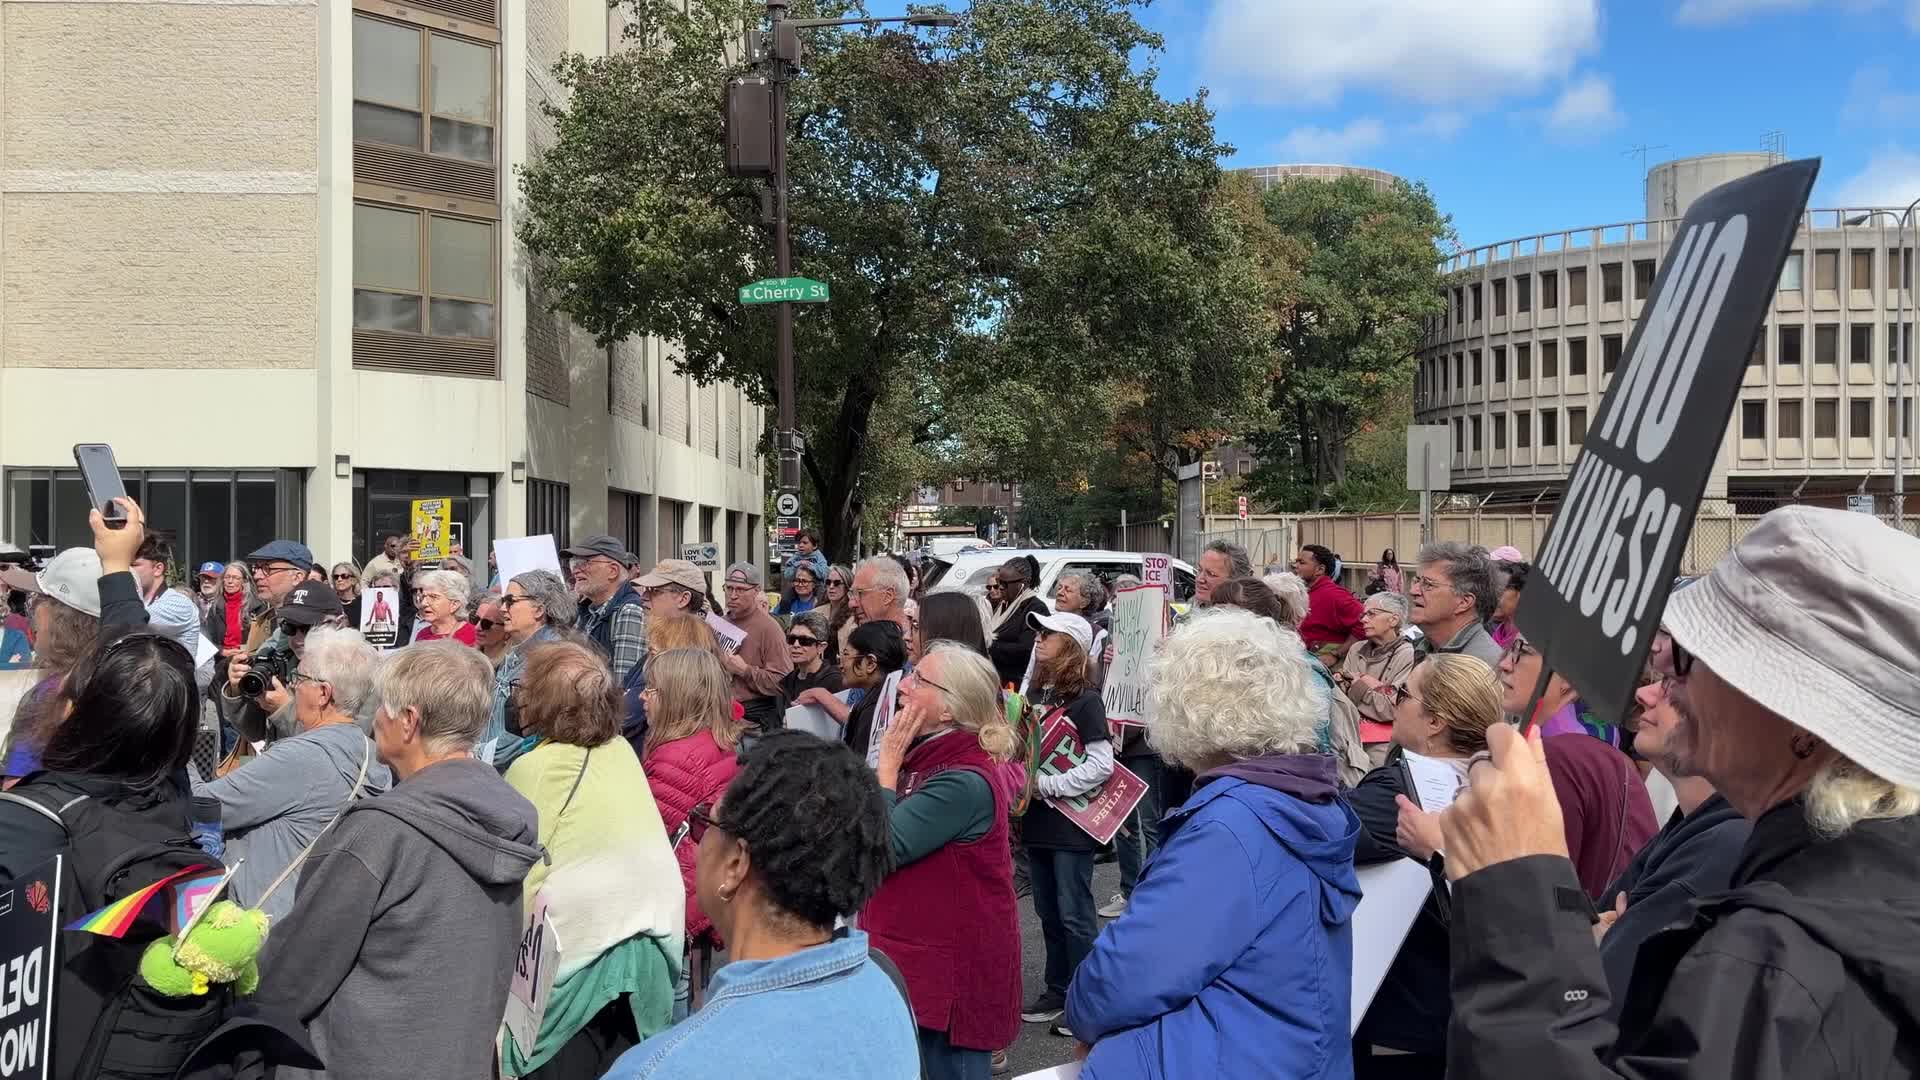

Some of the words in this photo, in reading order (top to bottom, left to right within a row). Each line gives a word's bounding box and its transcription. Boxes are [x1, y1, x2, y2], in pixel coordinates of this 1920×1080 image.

[753, 284, 804, 300] Cherry
[810, 285, 825, 297] St
[1600, 213, 1748, 464] NO
[1539, 449, 1681, 655] KINGS!
[1145, 570, 1161, 581] ICE
[293, 589, 308, 604] T
[1091, 779, 1128, 826] PHILLY
[1097, 790, 1109, 806] OF
